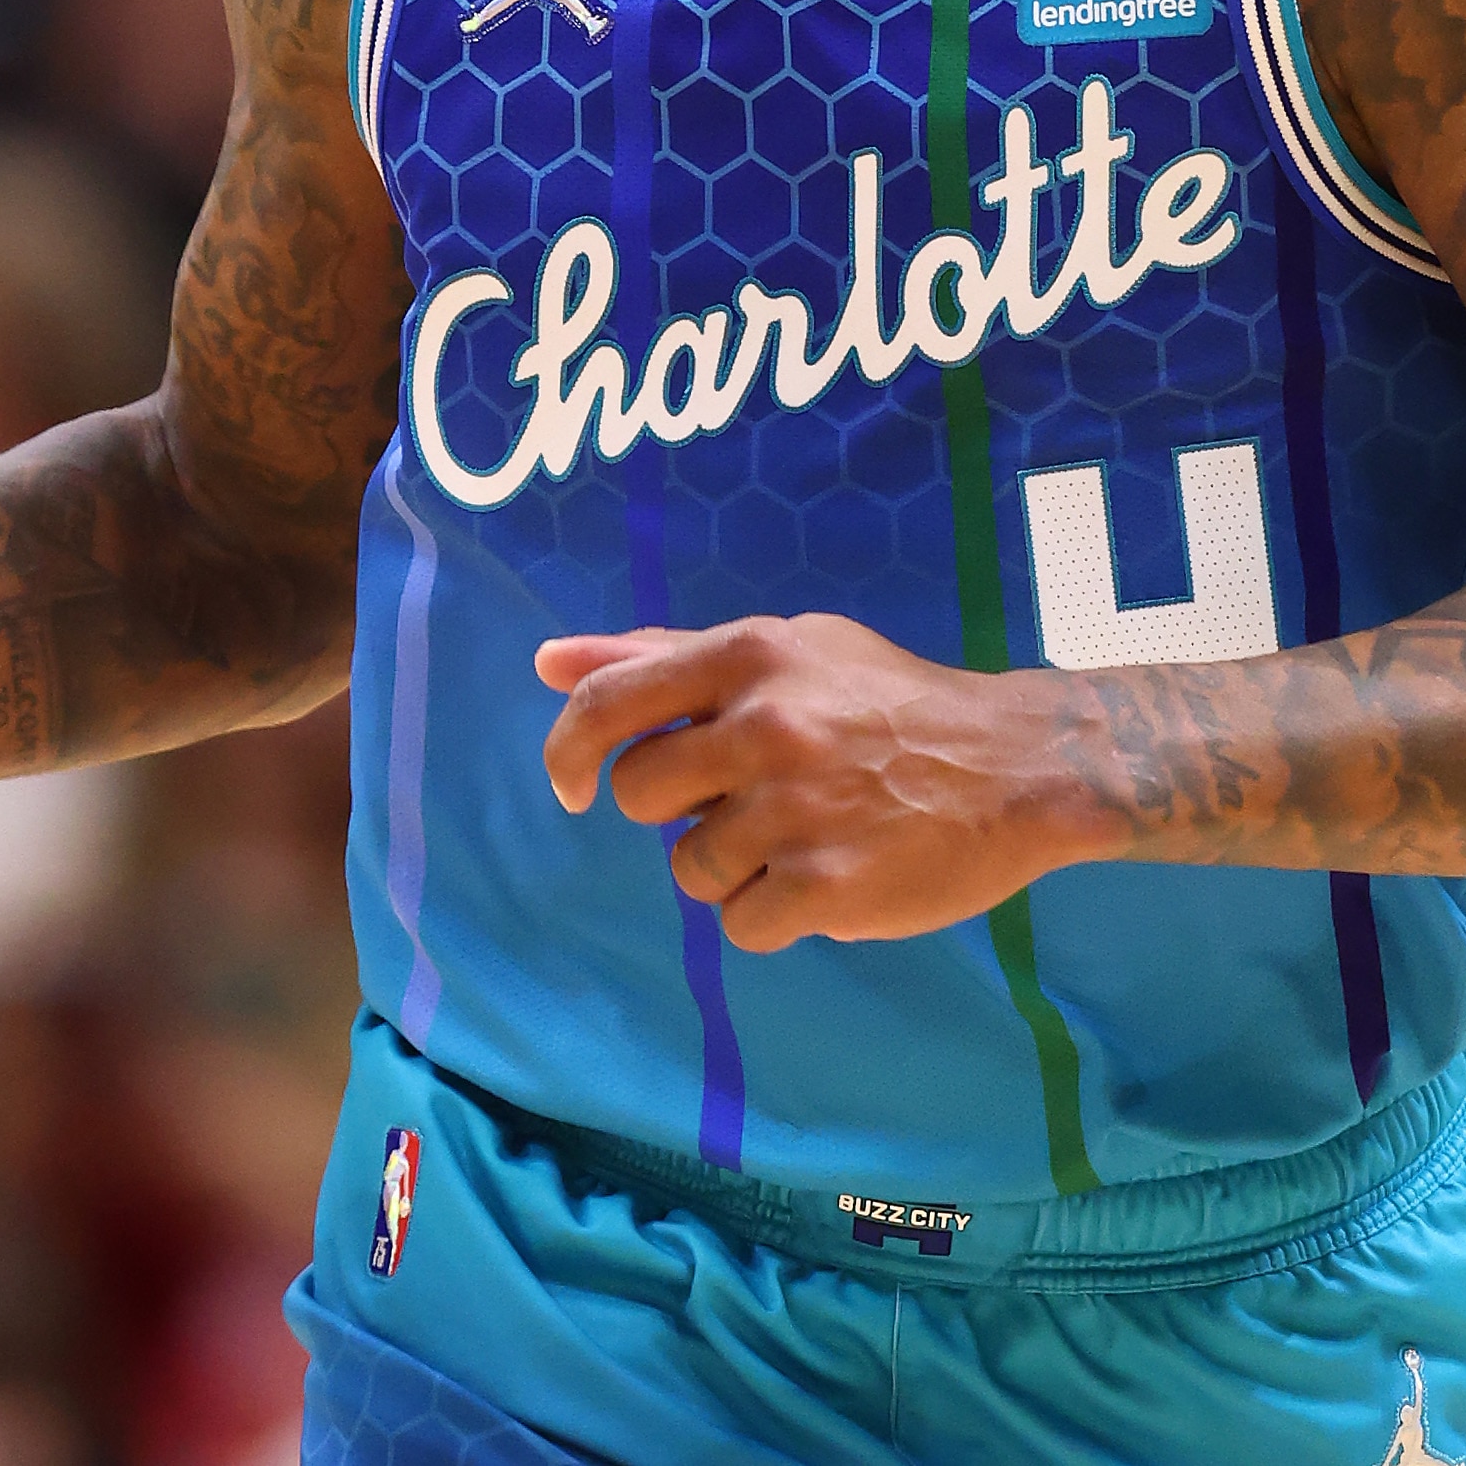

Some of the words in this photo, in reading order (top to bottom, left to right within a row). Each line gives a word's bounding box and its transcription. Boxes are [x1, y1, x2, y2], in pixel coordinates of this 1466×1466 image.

[408, 73, 1243, 513] Charlotte
[837, 1193, 905, 1225] BUZZ
[910, 1209, 973, 1232] CITY
